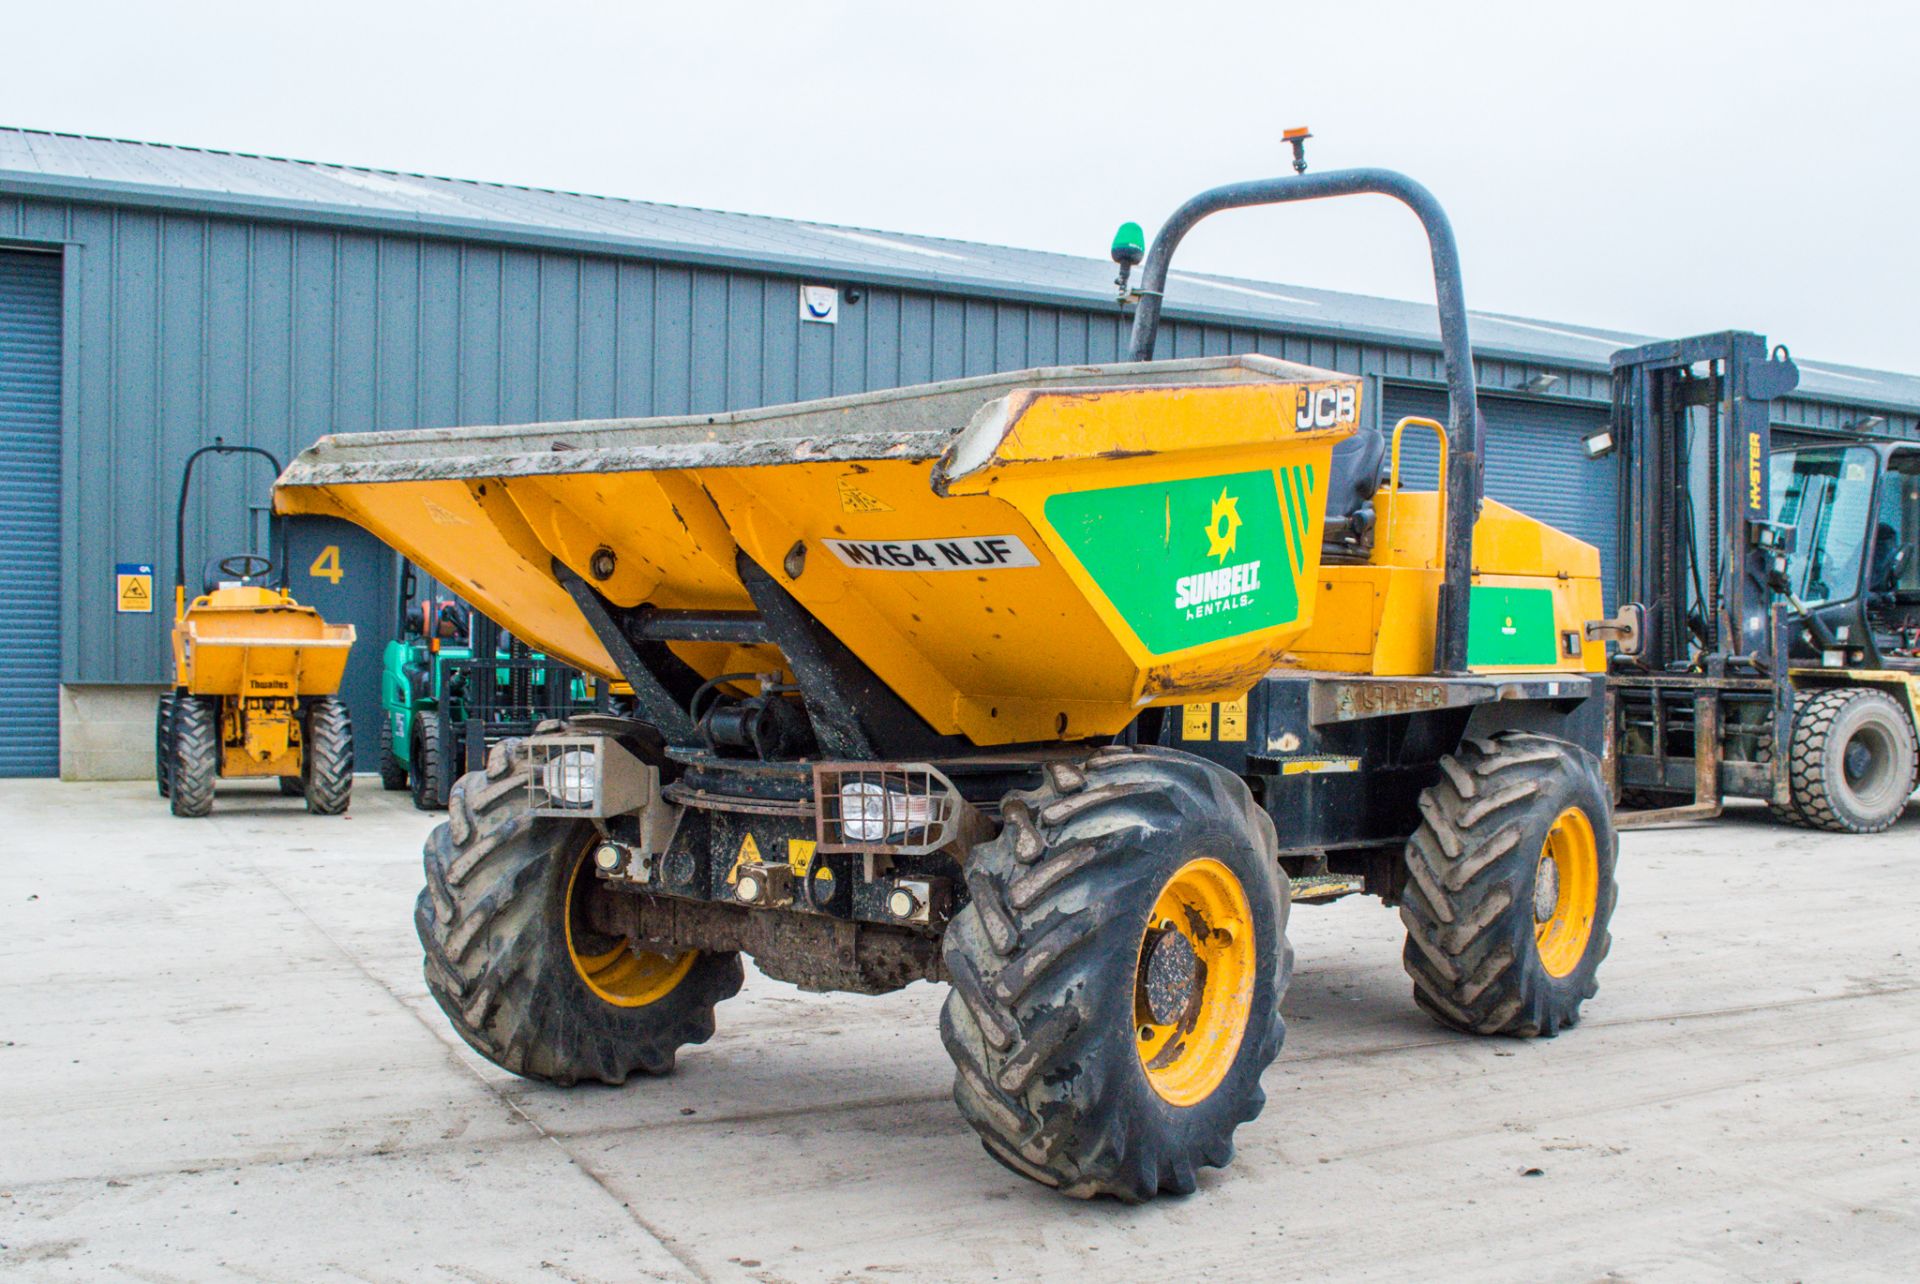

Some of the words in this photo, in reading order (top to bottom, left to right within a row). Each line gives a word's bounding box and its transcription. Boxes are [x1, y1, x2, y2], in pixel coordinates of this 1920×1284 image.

[1296, 387, 1356, 429] JCB
[1750, 432, 1761, 509] HYSTER
[309, 545, 344, 585] 4
[836, 542, 937, 567] MX64
[934, 539, 1013, 566] NJF
[1175, 560, 1260, 609] SUNBELT
[249, 679, 289, 689] Thwaites
